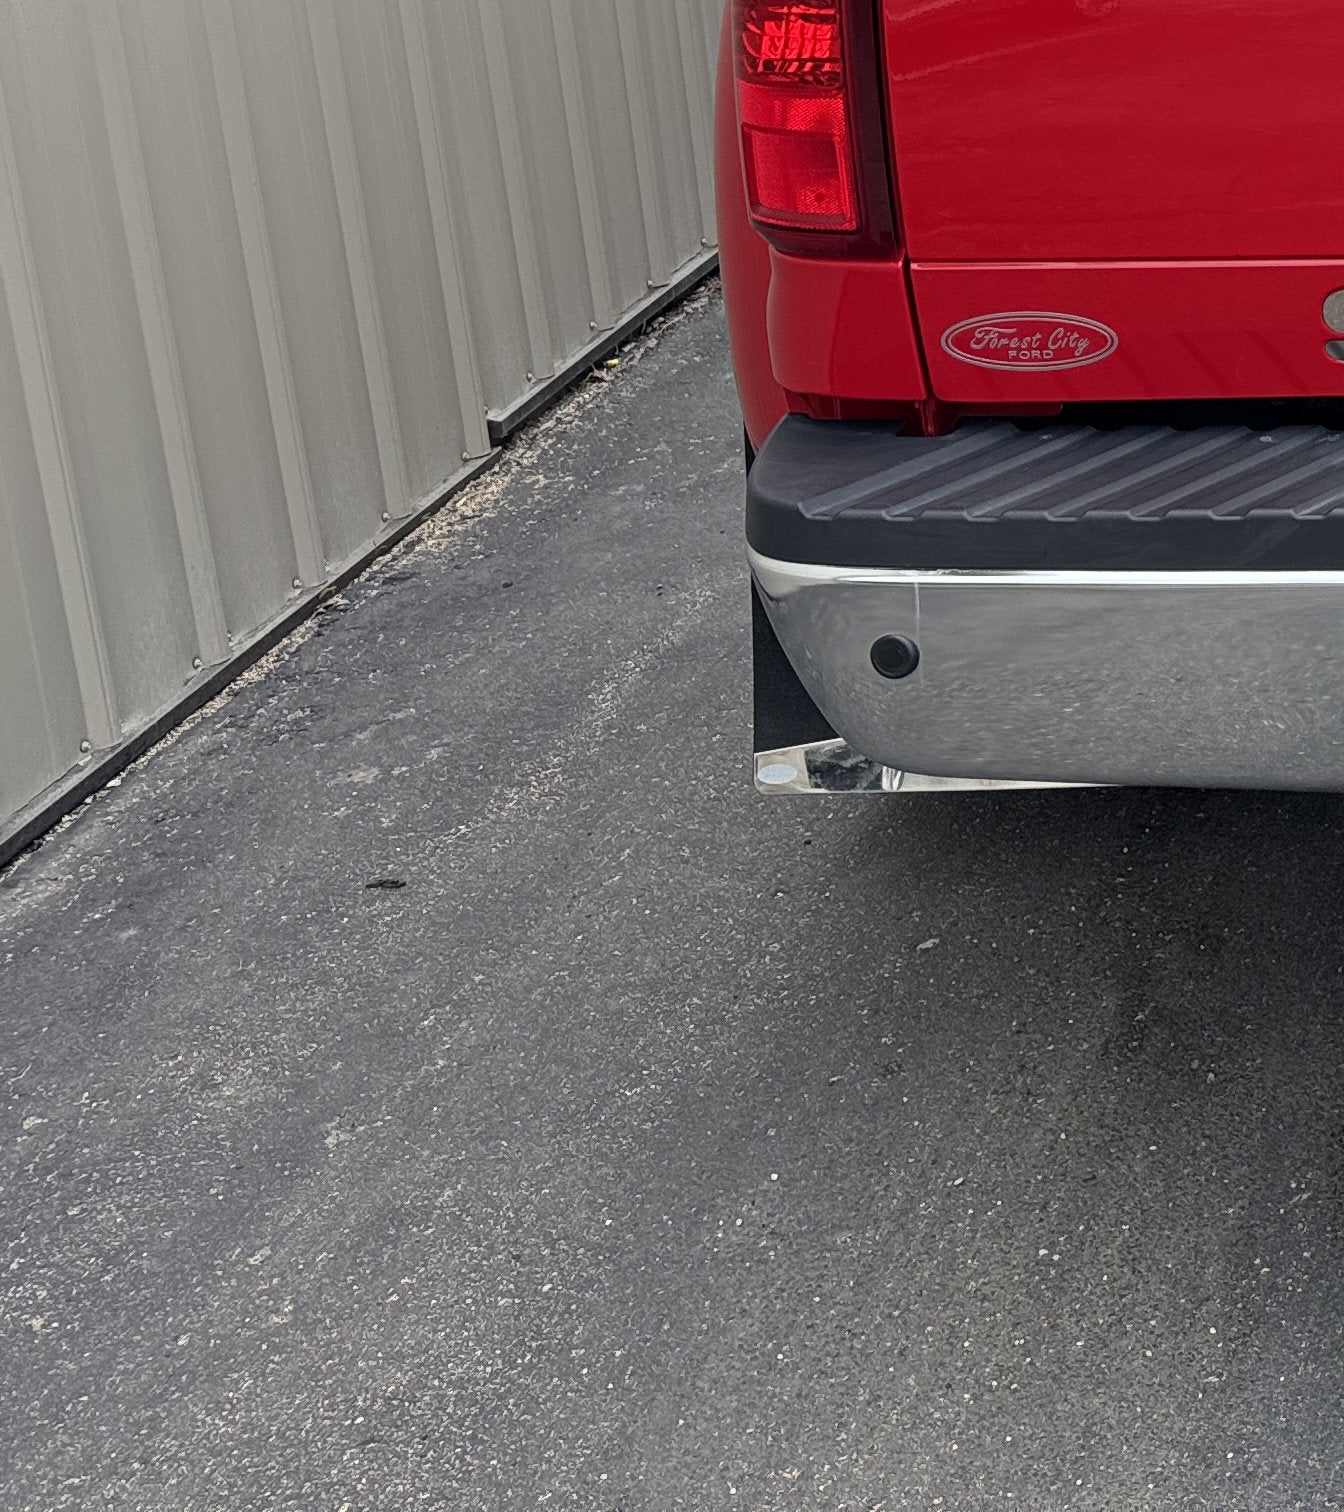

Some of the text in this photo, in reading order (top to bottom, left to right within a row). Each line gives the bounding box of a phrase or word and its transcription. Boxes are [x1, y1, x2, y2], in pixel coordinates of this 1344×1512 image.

[969, 326, 1090, 356] Forest City
[1008, 350, 1054, 360] FORD
